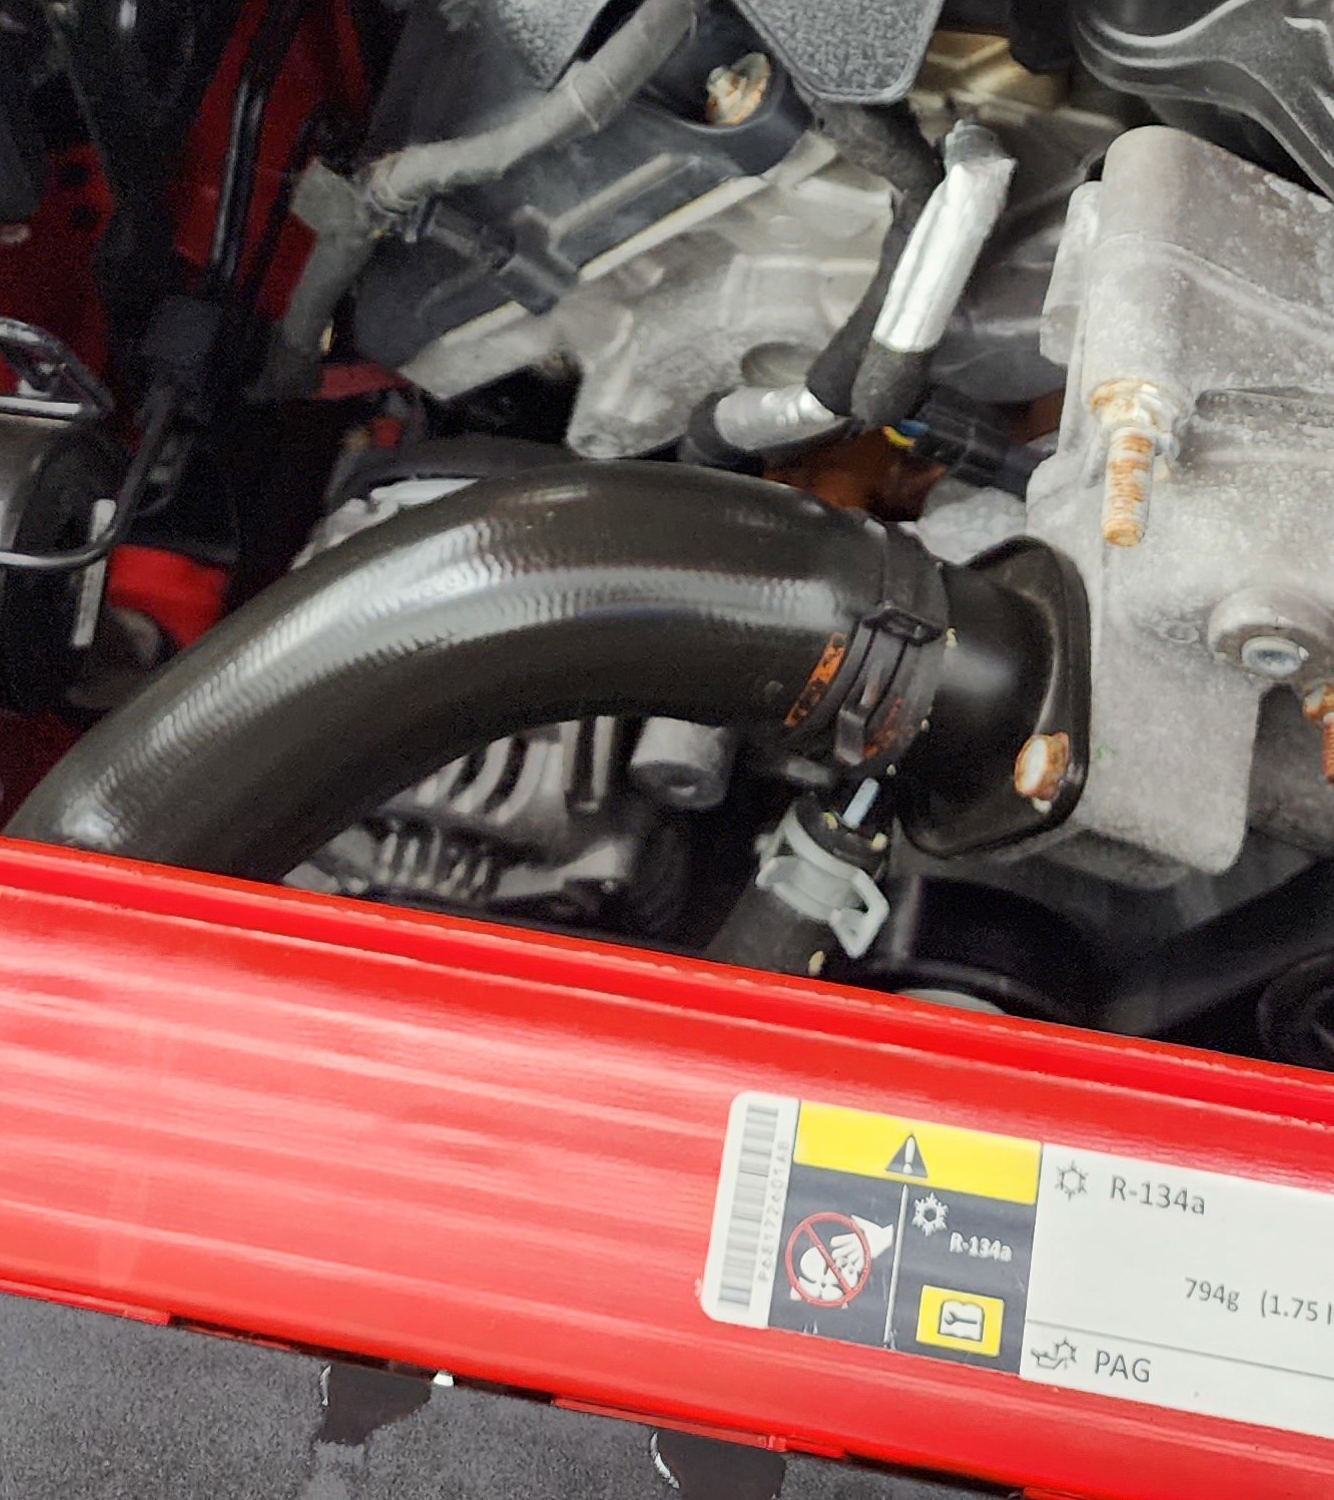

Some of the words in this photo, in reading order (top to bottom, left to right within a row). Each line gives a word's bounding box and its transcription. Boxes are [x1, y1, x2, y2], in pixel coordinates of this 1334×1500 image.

[1110, 1174, 1206, 1216] R-134a
[948, 1231, 1012, 1263] R-134a
[1184, 1276, 1240, 1313] 794g
[1260, 1290, 1318, 1324] (1.75
[1094, 1350, 1152, 1384] PAG
